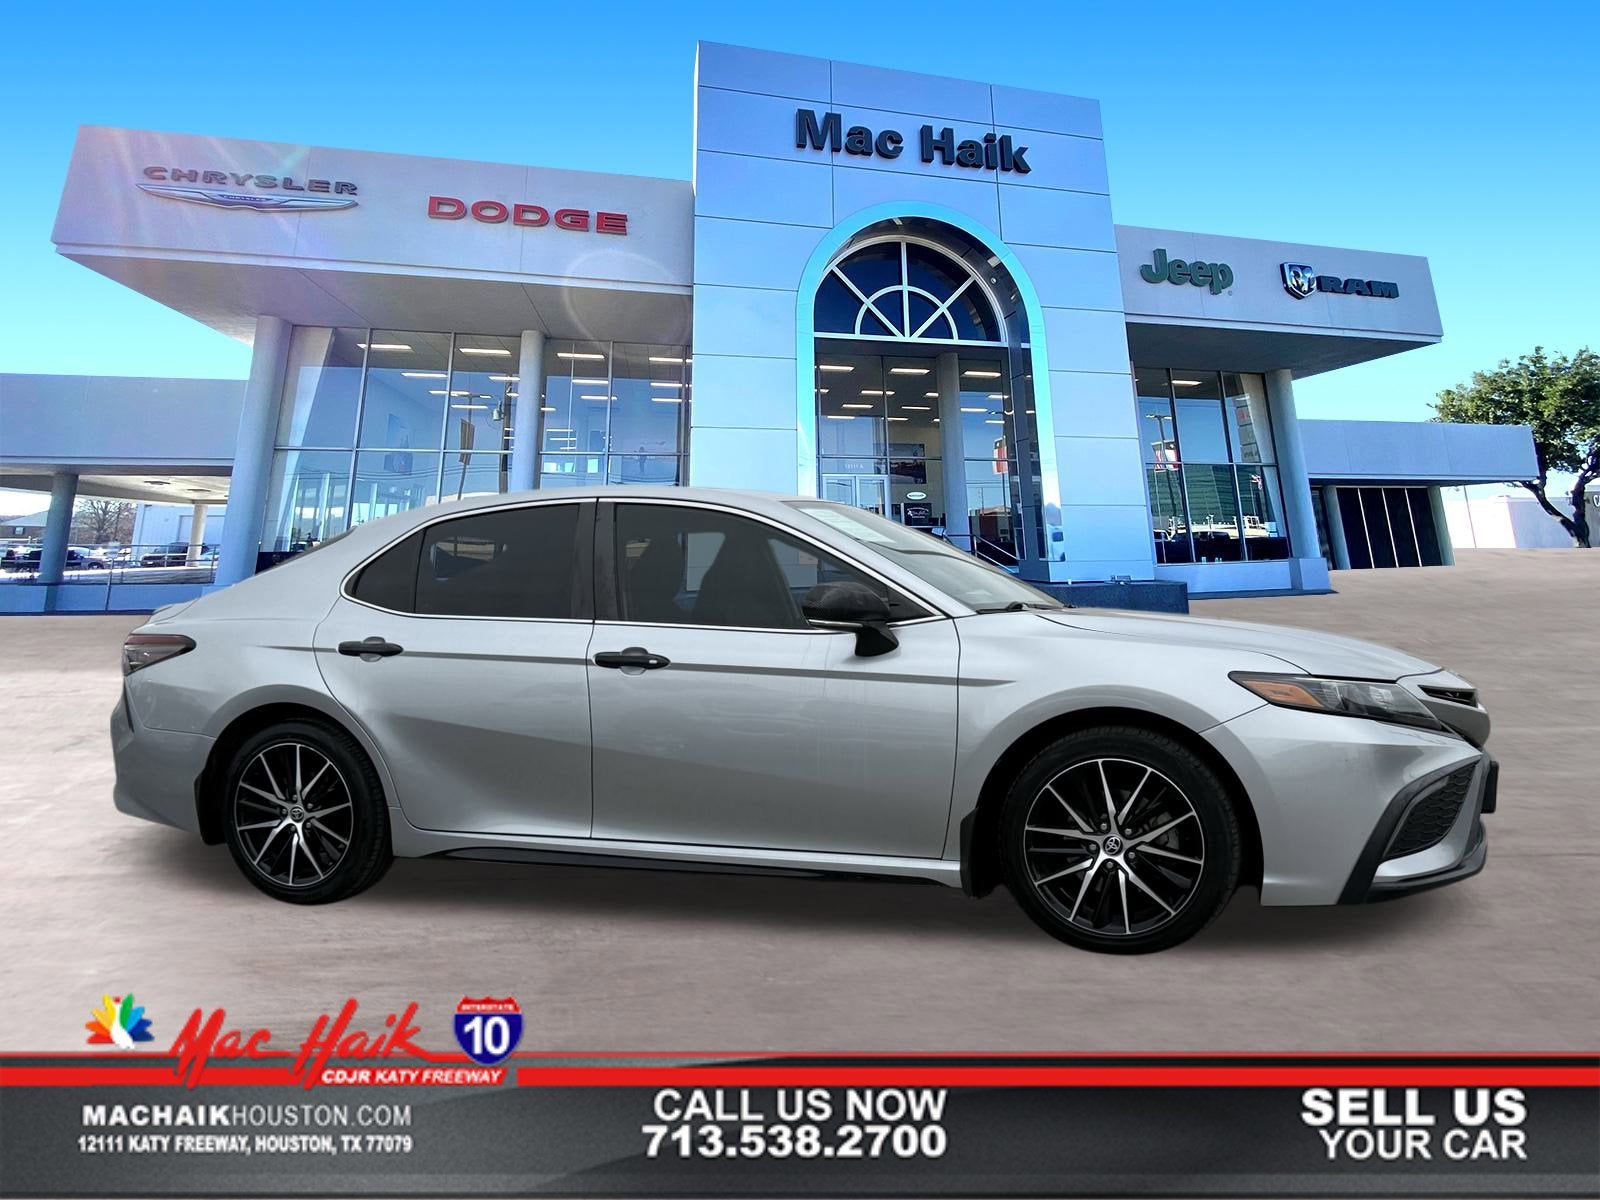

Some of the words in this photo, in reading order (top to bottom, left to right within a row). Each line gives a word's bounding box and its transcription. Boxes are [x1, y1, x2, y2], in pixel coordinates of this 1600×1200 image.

[796, 108, 904, 159] Mac
[919, 124, 1032, 174] Haik
[143, 166, 358, 196] CHRYSLER
[428, 196, 628, 236] DODGE
[1140, 248, 1234, 295] Jeep
[1316, 275, 1399, 299] RAM
